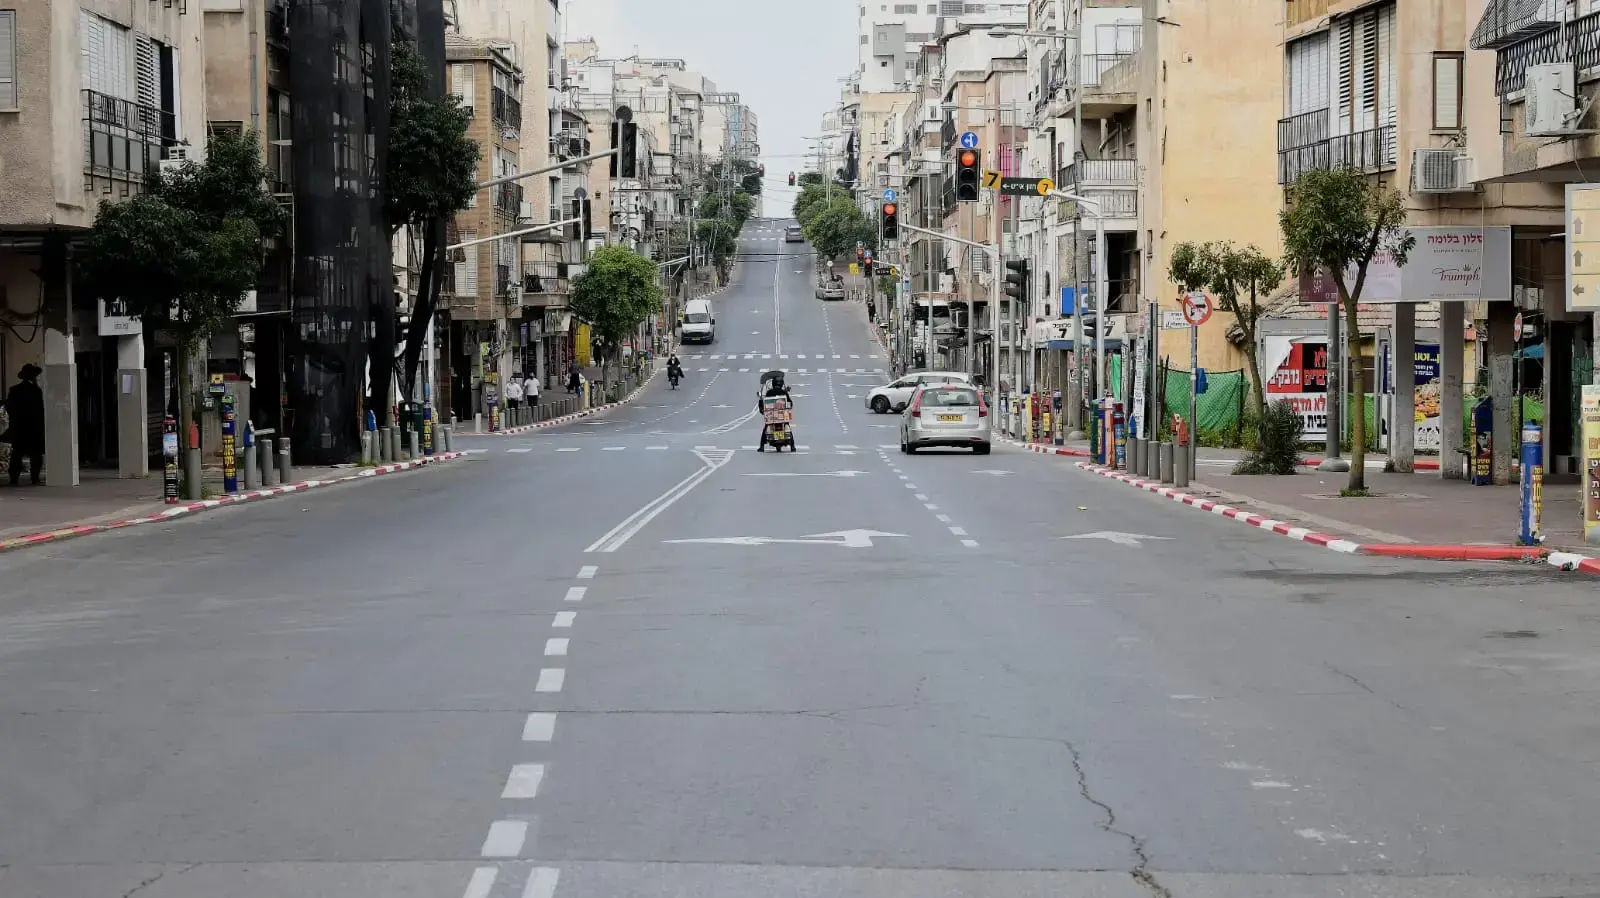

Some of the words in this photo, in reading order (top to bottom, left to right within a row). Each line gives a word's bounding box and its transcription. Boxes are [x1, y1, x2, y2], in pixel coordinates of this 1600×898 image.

[988, 172, 998, 186] 7
[1427, 233, 1460, 244] בלומה
[1431, 265, 1481, 286] Triumph
[1059, 328, 1067, 338] 7
[1103, 326, 1113, 336] 7
[1314, 394, 1326, 411] לא
